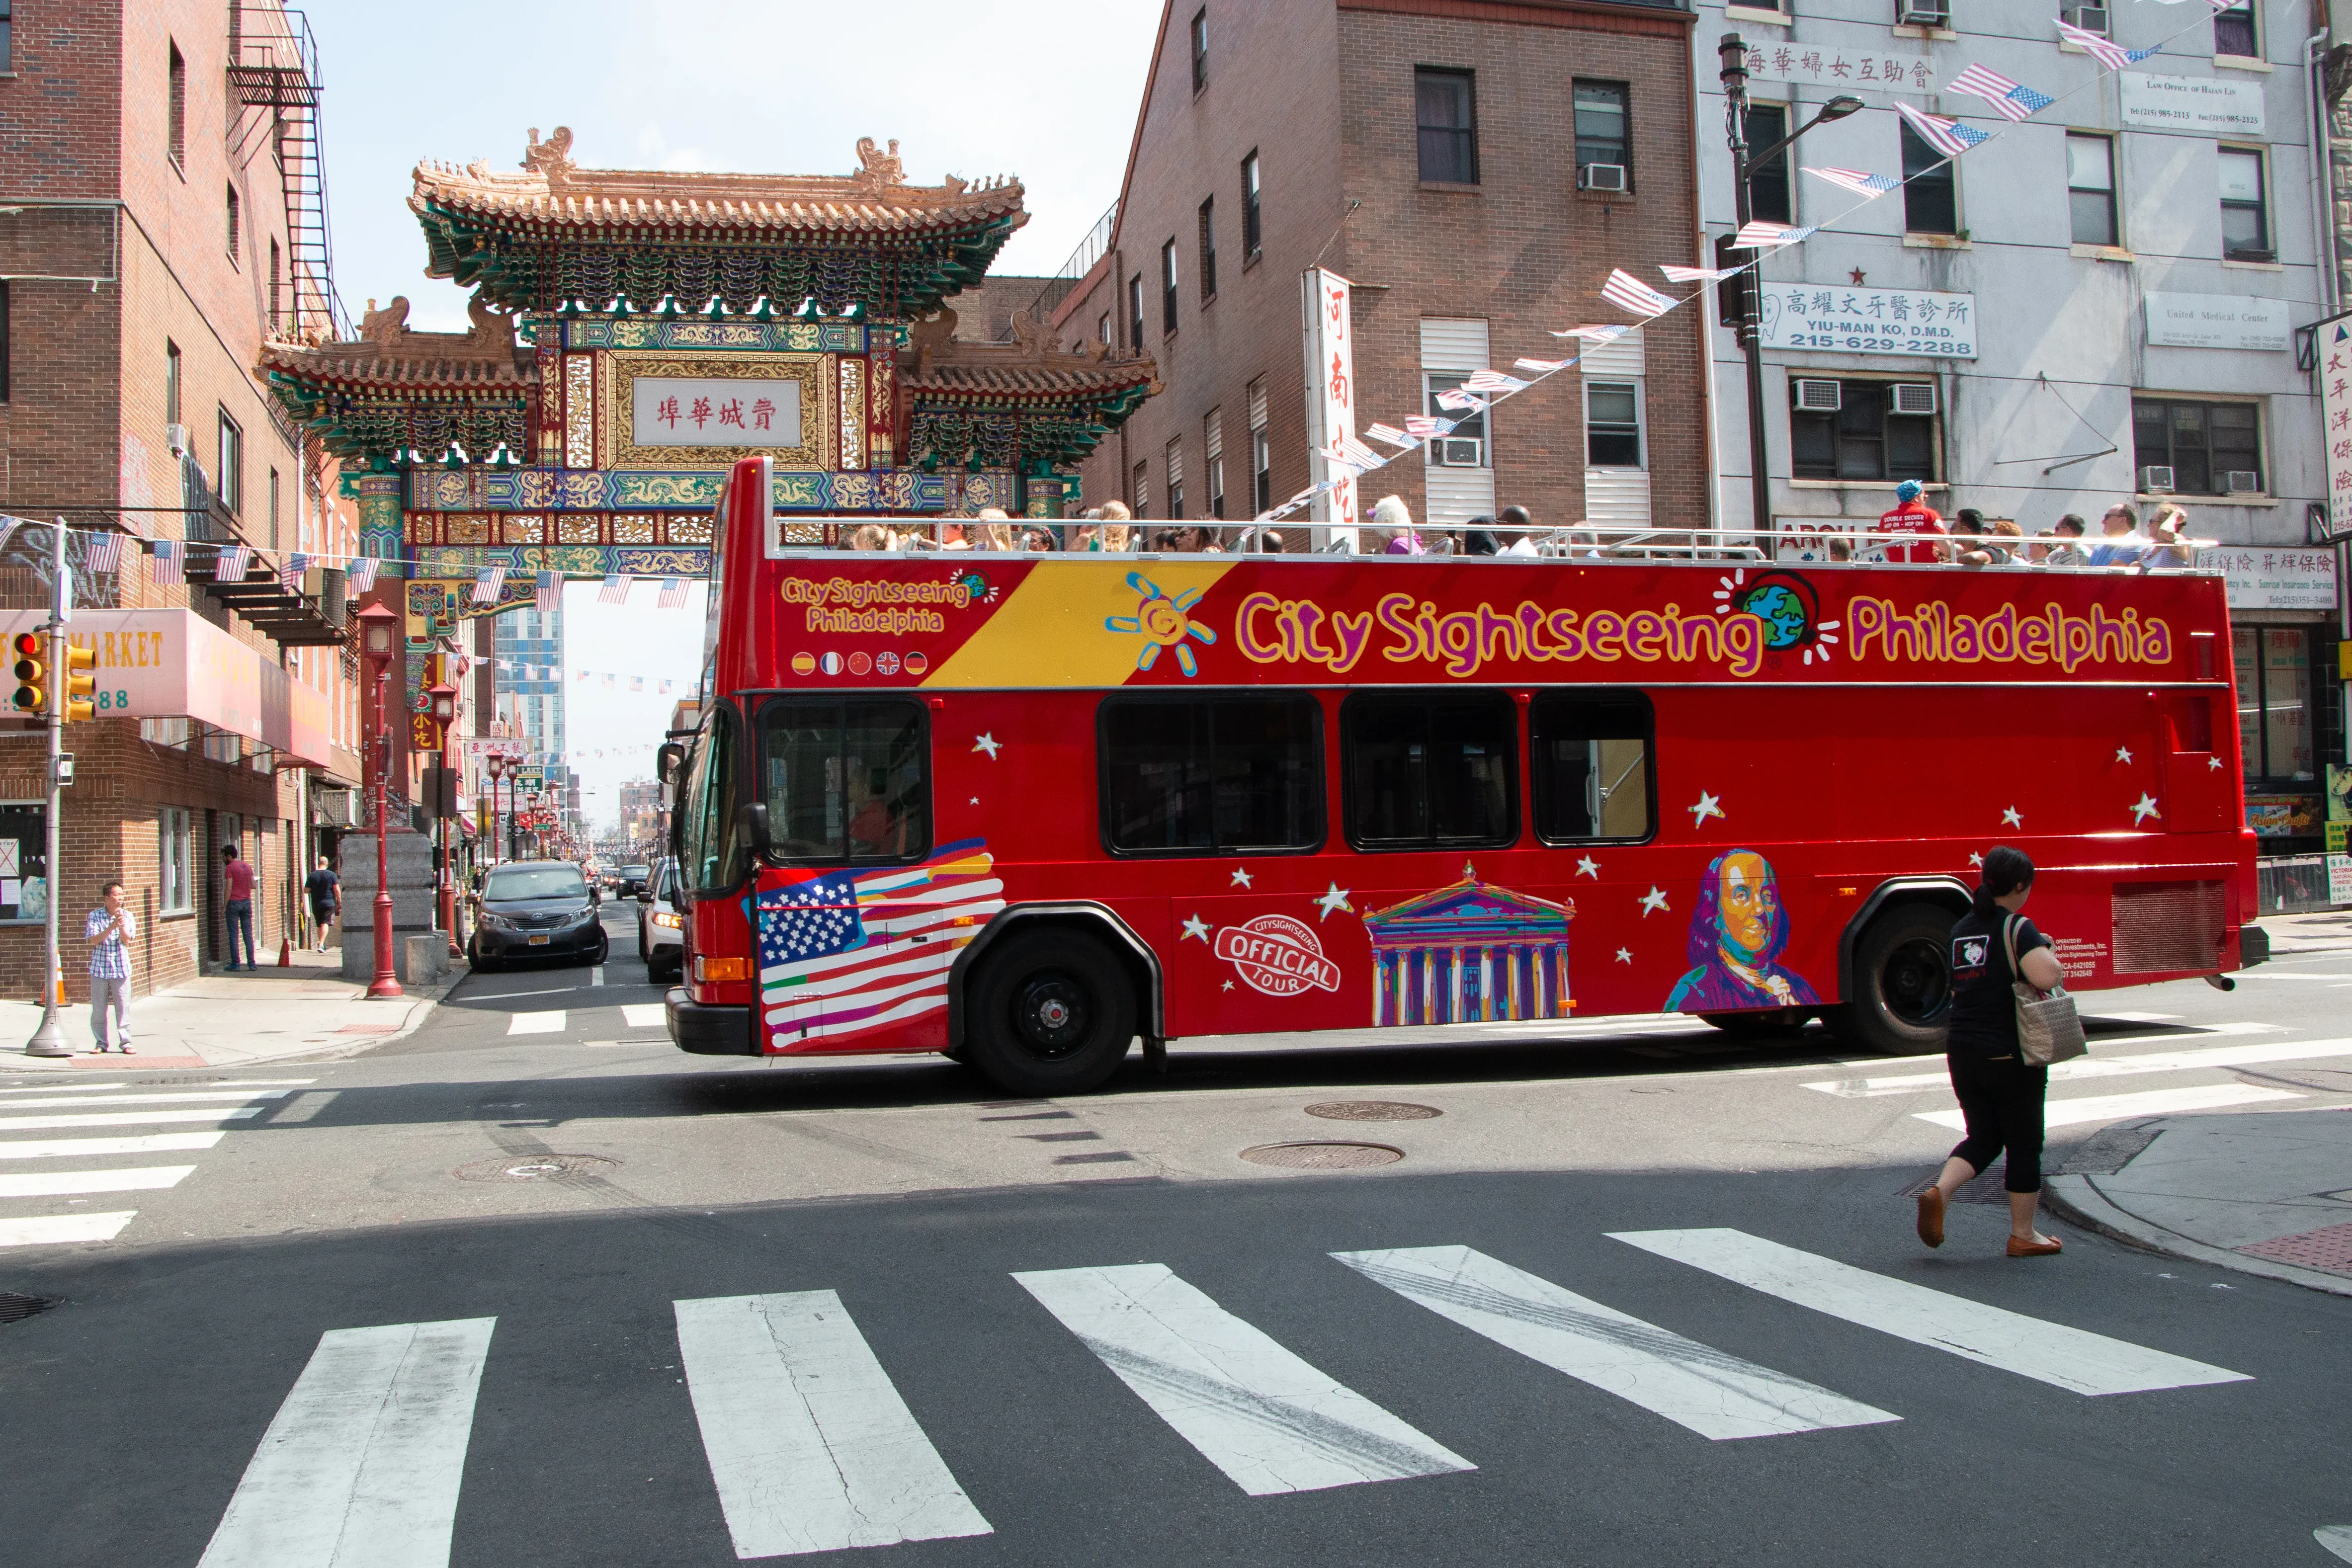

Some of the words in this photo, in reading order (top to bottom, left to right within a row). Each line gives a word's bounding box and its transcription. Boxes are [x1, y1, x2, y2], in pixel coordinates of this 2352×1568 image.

[2158, 109, 2189, 119] 985-2113
[1786, 289, 1969, 325] 高耀文牙醫診所
[2167, 310, 2194, 319] United
[2202, 311, 2235, 322] Medical
[2242, 313, 2268, 323] Center
[1807, 320, 1874, 334] YIU-MAN
[1881, 324, 1906, 337] KO,
[1911, 326, 1954, 338] D.M.D.
[1789, 333, 1971, 355] 215-629-2288
[2200, 552, 2254, 572] 洋保險
[2242, 579, 2252, 588] Inc.
[2259, 578, 2280, 589] Sunrise
[2282, 579, 2309, 589] Insurance
[2312, 579, 2334, 589] Service
[806, 606, 945, 636] Philadelphia
[1848, 596, 2173, 673] Philadelphia
[1255, 919, 1317, 951] CITYSIGHTSEEING
[1230, 935, 1330, 986] OFFICIAL
[1253, 967, 1300, 991] TOUR
[2070, 970, 2092, 978] 3142649
